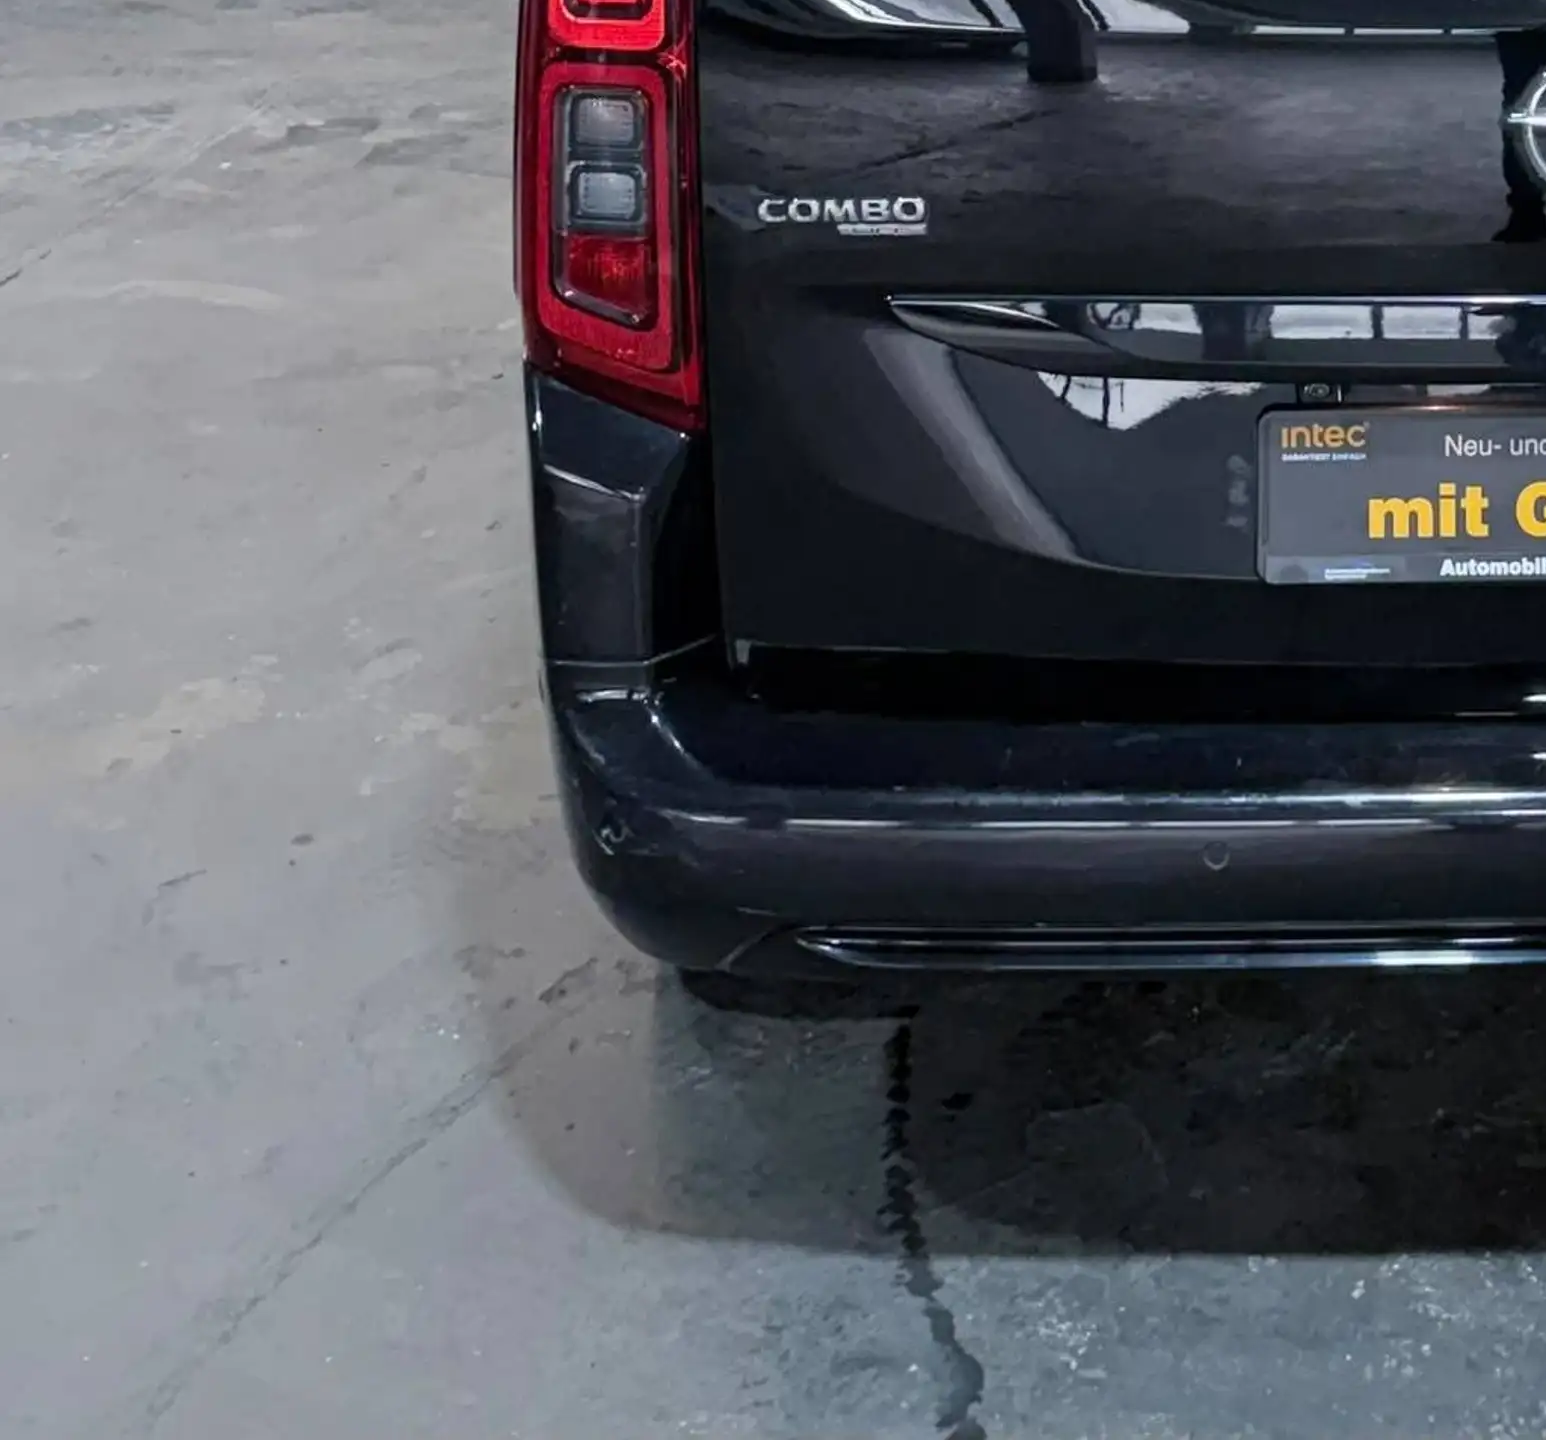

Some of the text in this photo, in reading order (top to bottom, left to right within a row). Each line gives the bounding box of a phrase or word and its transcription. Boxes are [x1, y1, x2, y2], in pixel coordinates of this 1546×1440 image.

[758, 197, 926, 223] COMBO
[1445, 436, 1502, 457] Neu-
[1368, 482, 1490, 539] mit
